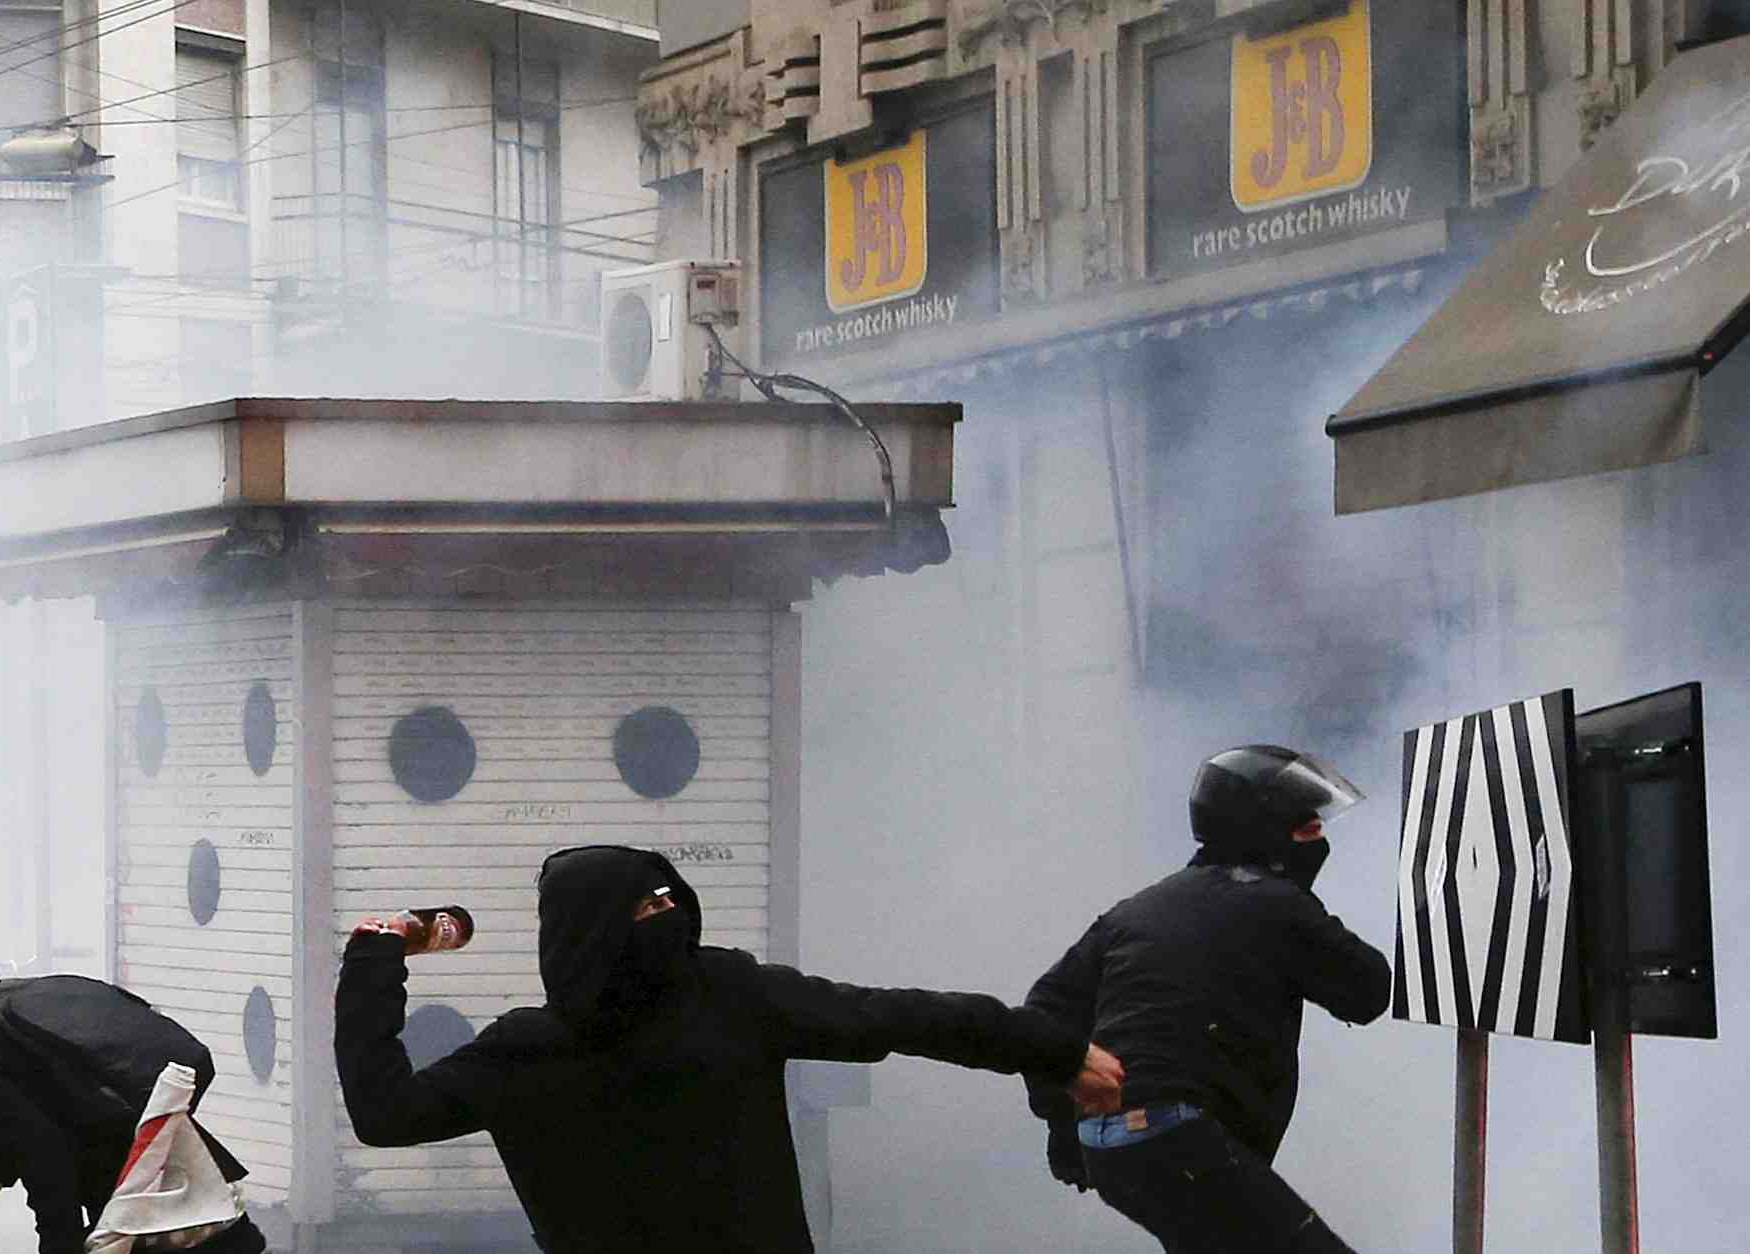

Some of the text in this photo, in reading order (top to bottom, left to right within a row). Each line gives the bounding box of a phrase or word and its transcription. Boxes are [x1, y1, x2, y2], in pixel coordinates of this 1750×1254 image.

[1250, 36, 1345, 189] J&B
[840, 163, 907, 292] J&B
[1193, 186, 1411, 258] rare scotch whisky
[796, 293, 958, 351] rare scotch whisky
